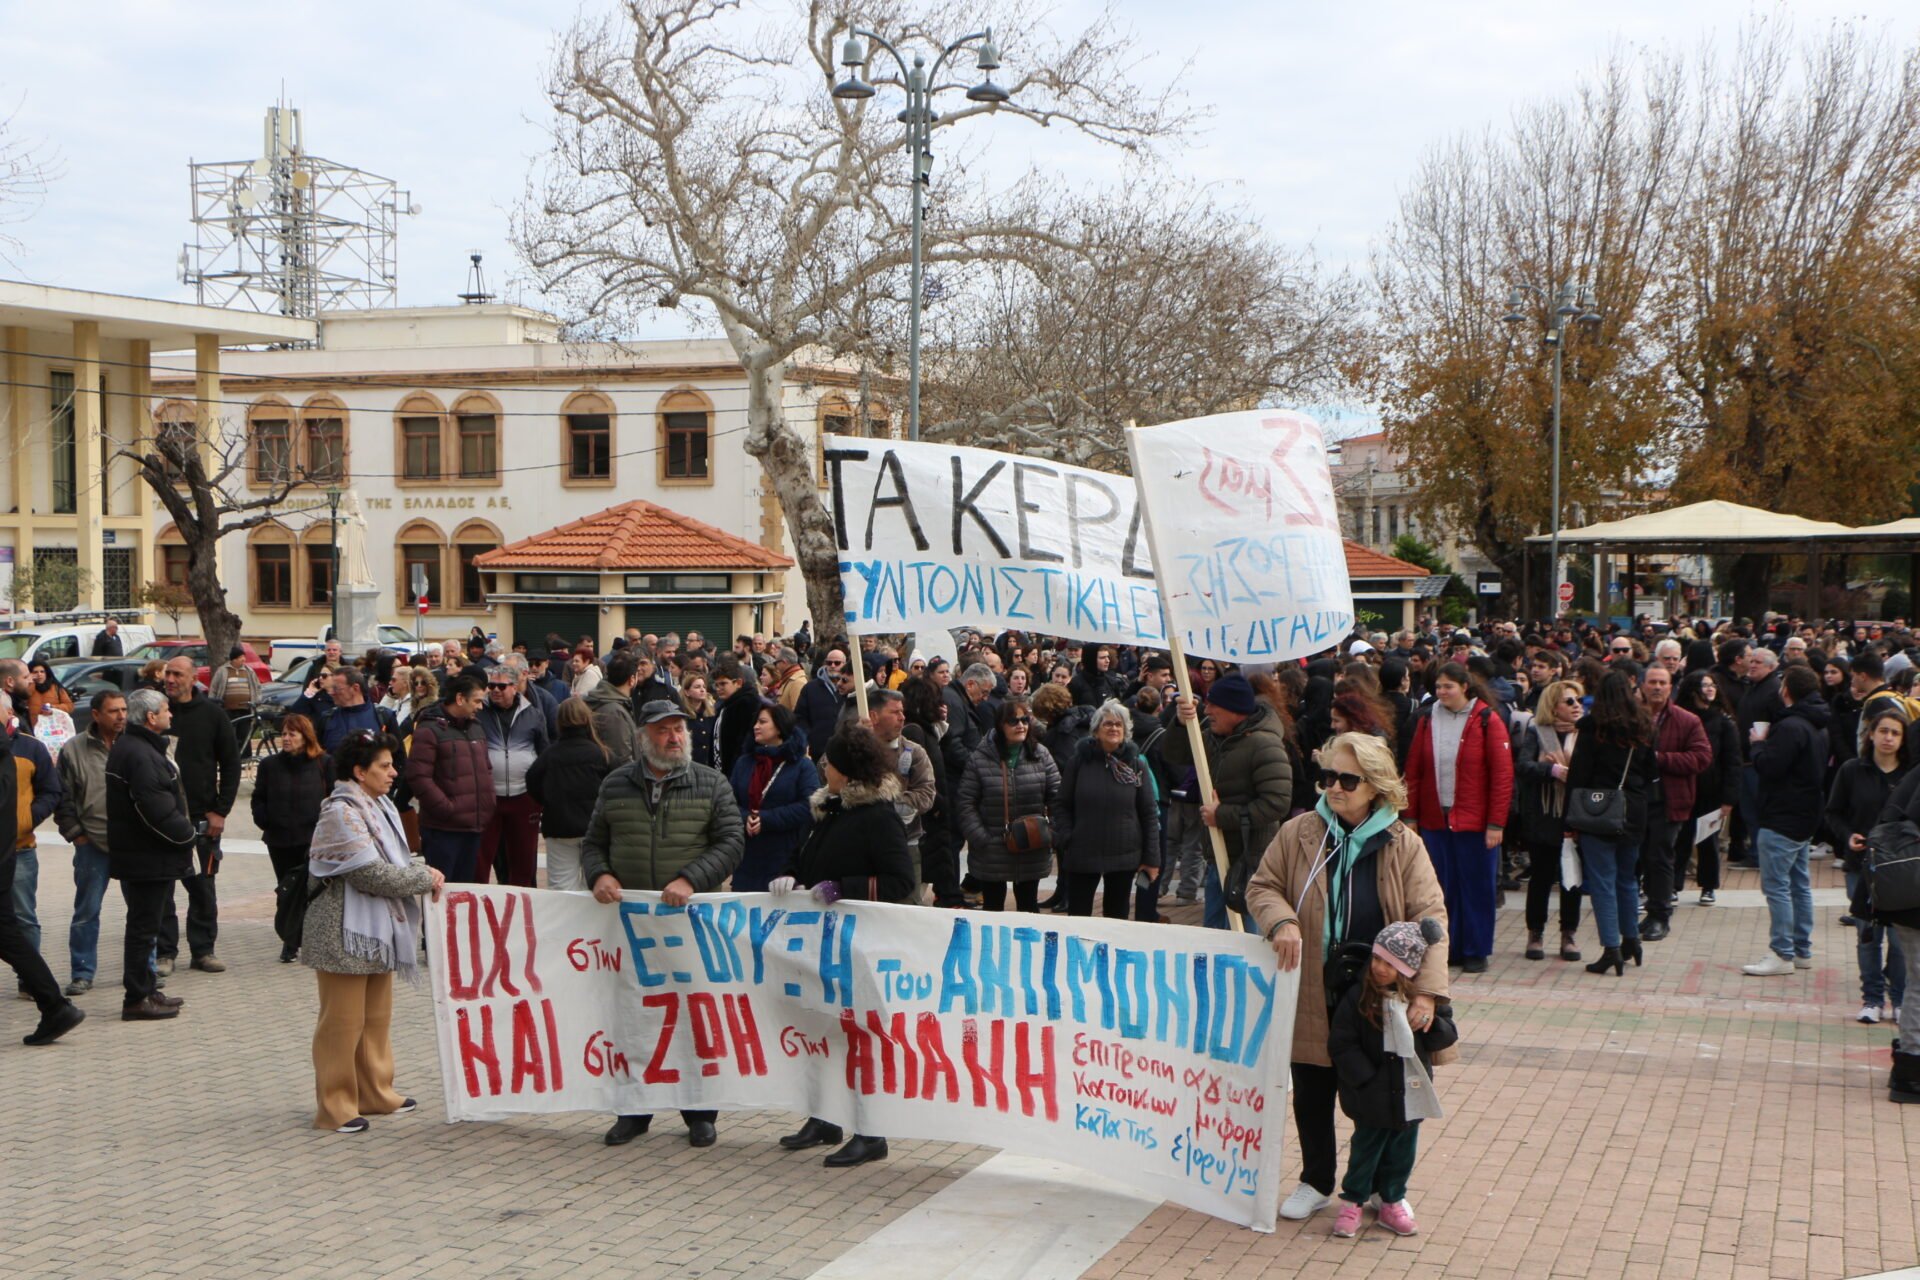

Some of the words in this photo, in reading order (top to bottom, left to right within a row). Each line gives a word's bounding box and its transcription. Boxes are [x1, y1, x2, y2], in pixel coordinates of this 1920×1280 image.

[365, 498, 392, 510] ΤΗΣ
[404, 497, 475, 510] ΕΛΛΑΔΟΣ
[823, 449, 930, 551] ΤΑ
[446, 891, 543, 1000] ΟΧΙ
[619, 899, 856, 1007] ΕΞΟΡΥΞΗ
[938, 917, 1276, 1068] ΑΝΤΙΜΟΝΙΟΥ
[456, 998, 563, 1098] ΝΑΙ
[642, 992, 768, 1084] ΖΩΗ
